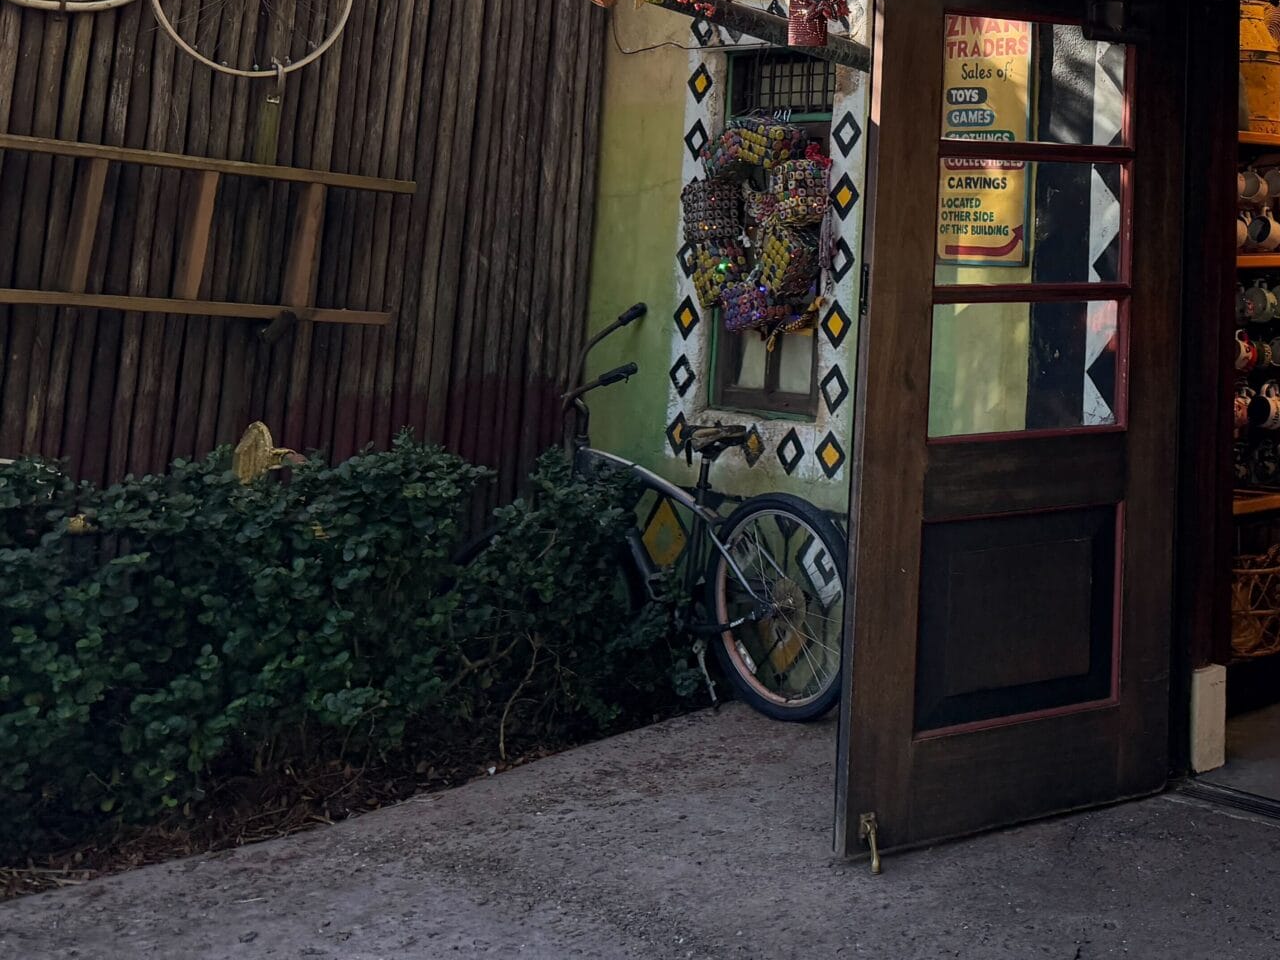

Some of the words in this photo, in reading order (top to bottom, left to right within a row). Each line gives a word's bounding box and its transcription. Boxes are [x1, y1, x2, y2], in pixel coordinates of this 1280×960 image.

[947, 36, 1028, 59] TRADERS
[961, 62, 992, 81] Sales
[950, 89, 979, 103] TOYS
[951, 109, 991, 123] GAMES
[948, 176, 1007, 189] CARVINGS
[941, 197, 981, 209] LOCATED
[941, 211, 971, 222] OTHER
[973, 211, 995, 221] SIDE
[940, 224, 950, 234] OF
[952, 224, 968, 234] THIS
[971, 224, 1009, 236] BUILDING
